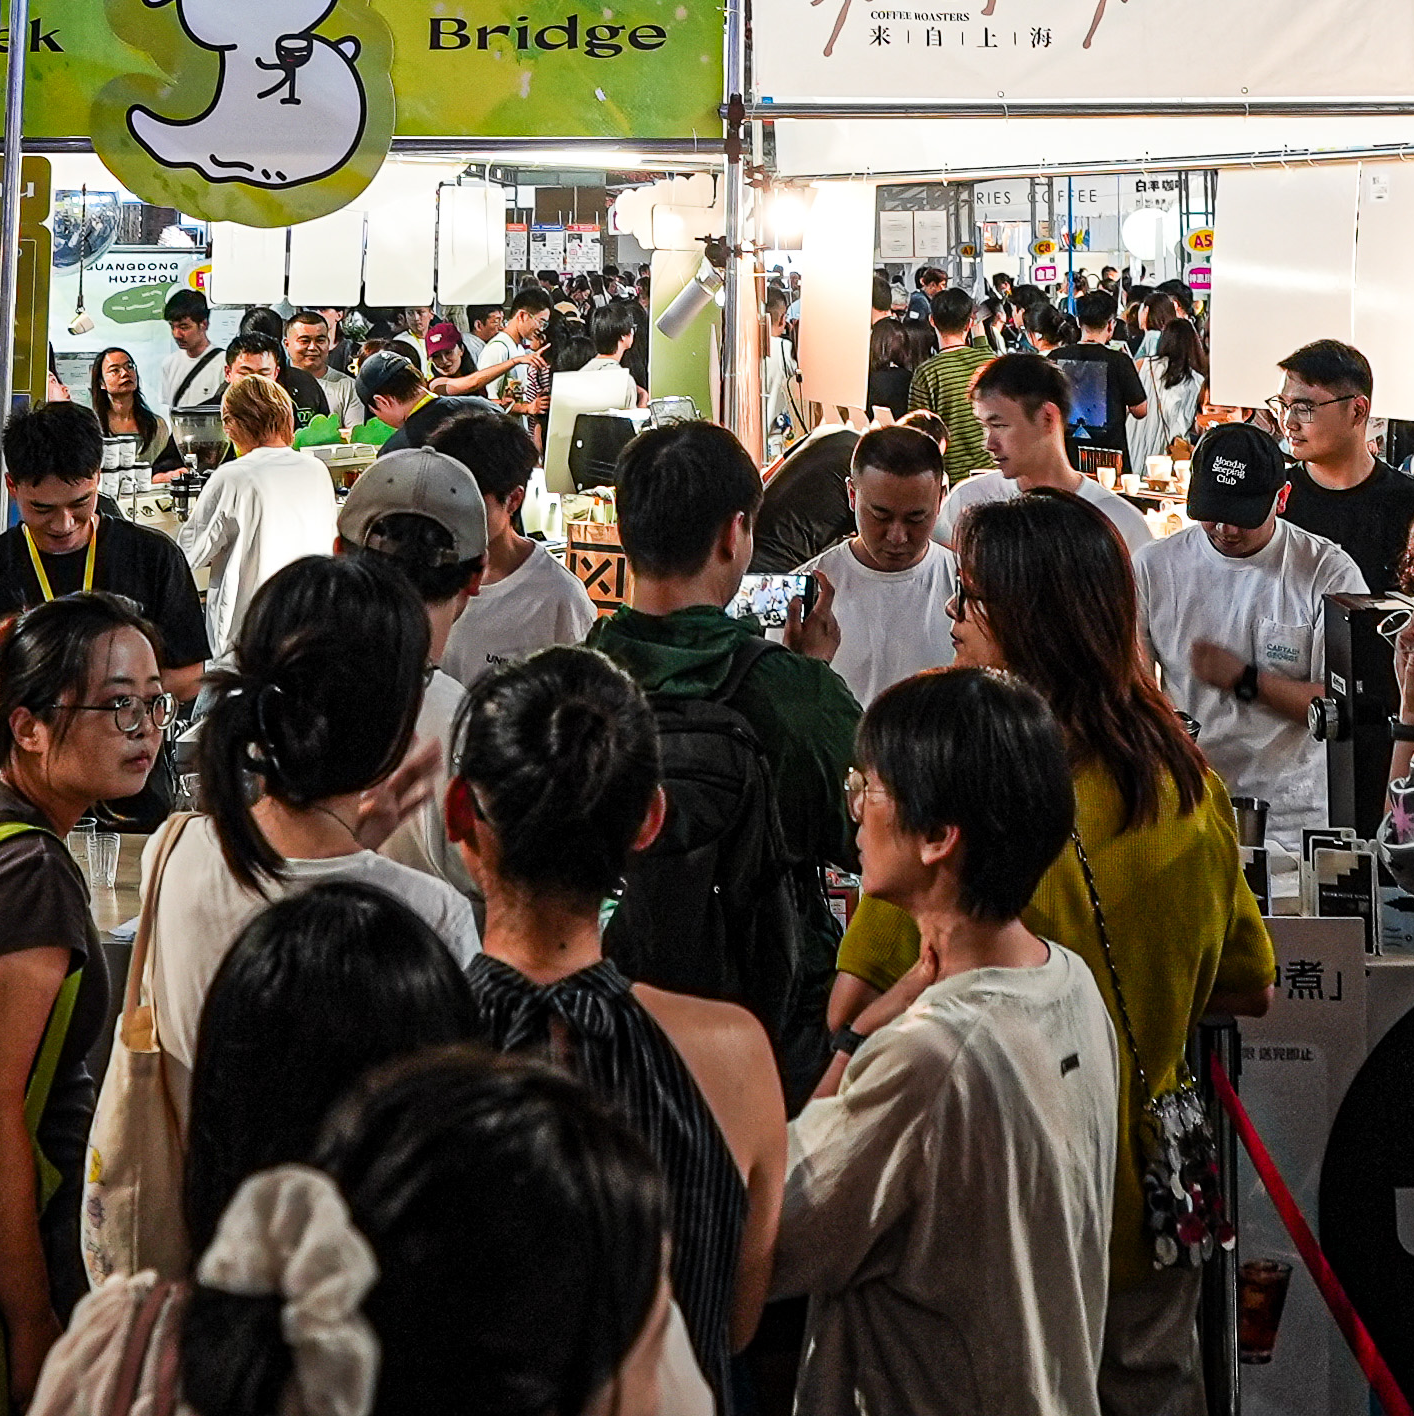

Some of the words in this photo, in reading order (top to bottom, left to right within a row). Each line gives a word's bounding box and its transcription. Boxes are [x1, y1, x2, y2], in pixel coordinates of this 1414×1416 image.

[870, 10, 909, 21] COFFEE
[914, 12, 970, 22] ROASTERS
[429, 14, 667, 59] Bridge
[1194, 234, 1213, 248] A5
[109, 274, 179, 284] HUIZHOU
[1217, 473, 1237, 486] Club
[1275, 959, 1342, 1002] 煮」
